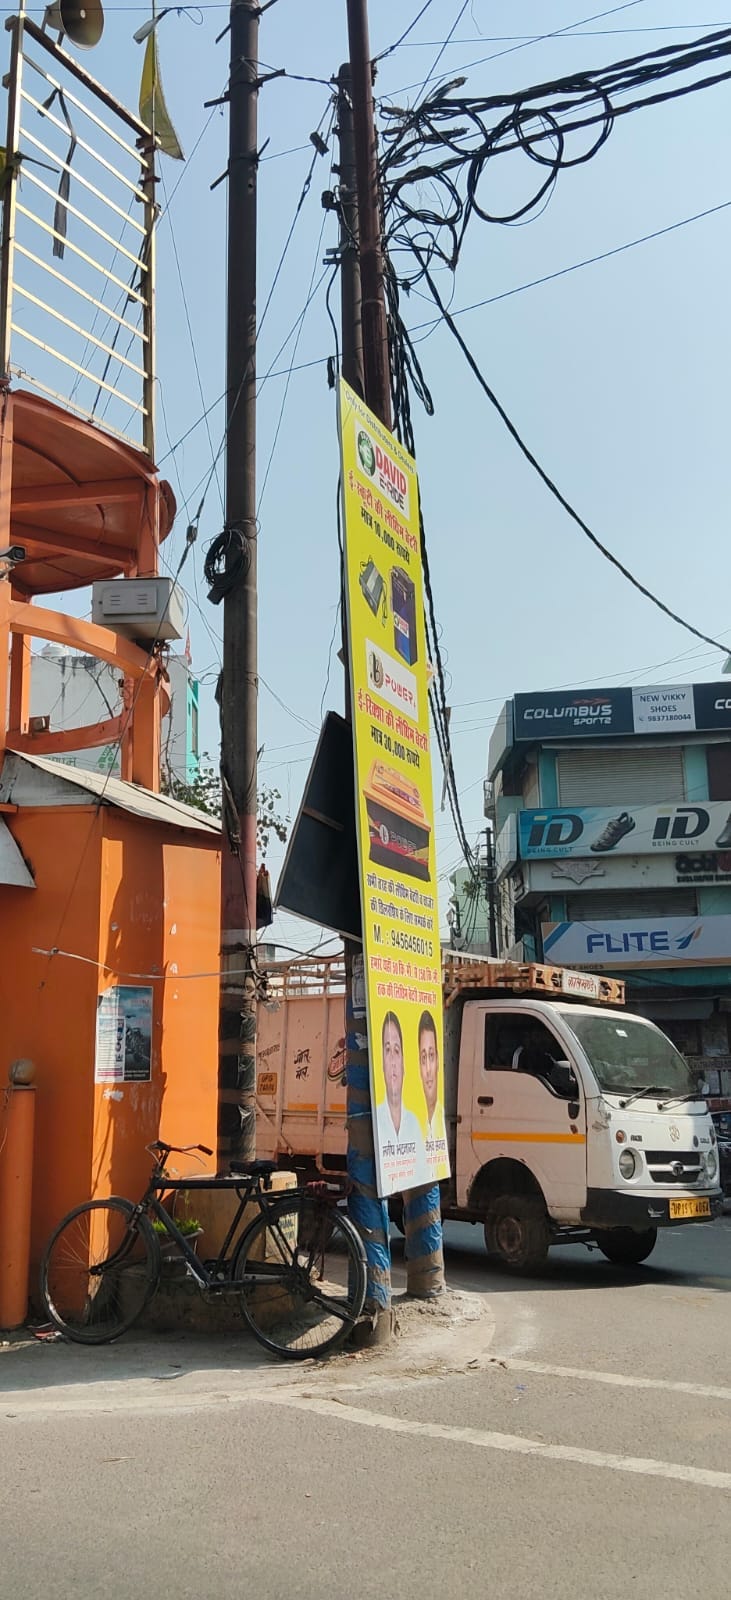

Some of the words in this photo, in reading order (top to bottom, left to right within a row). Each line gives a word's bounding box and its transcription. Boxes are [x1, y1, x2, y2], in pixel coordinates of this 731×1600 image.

[345, 391, 358, 409] Only
[375, 445, 407, 495] DAVID
[361, 505, 373, 529] मात्र
[374, 499, 383, 518] की
[524, 705, 612, 720] COLUMBUS
[650, 705, 677, 713] SHOES
[385, 710, 394, 730] की
[370, 725, 383, 747] मात्र
[391, 930, 433, 957] 9456456015
[586, 931, 669, 953] FLITE
